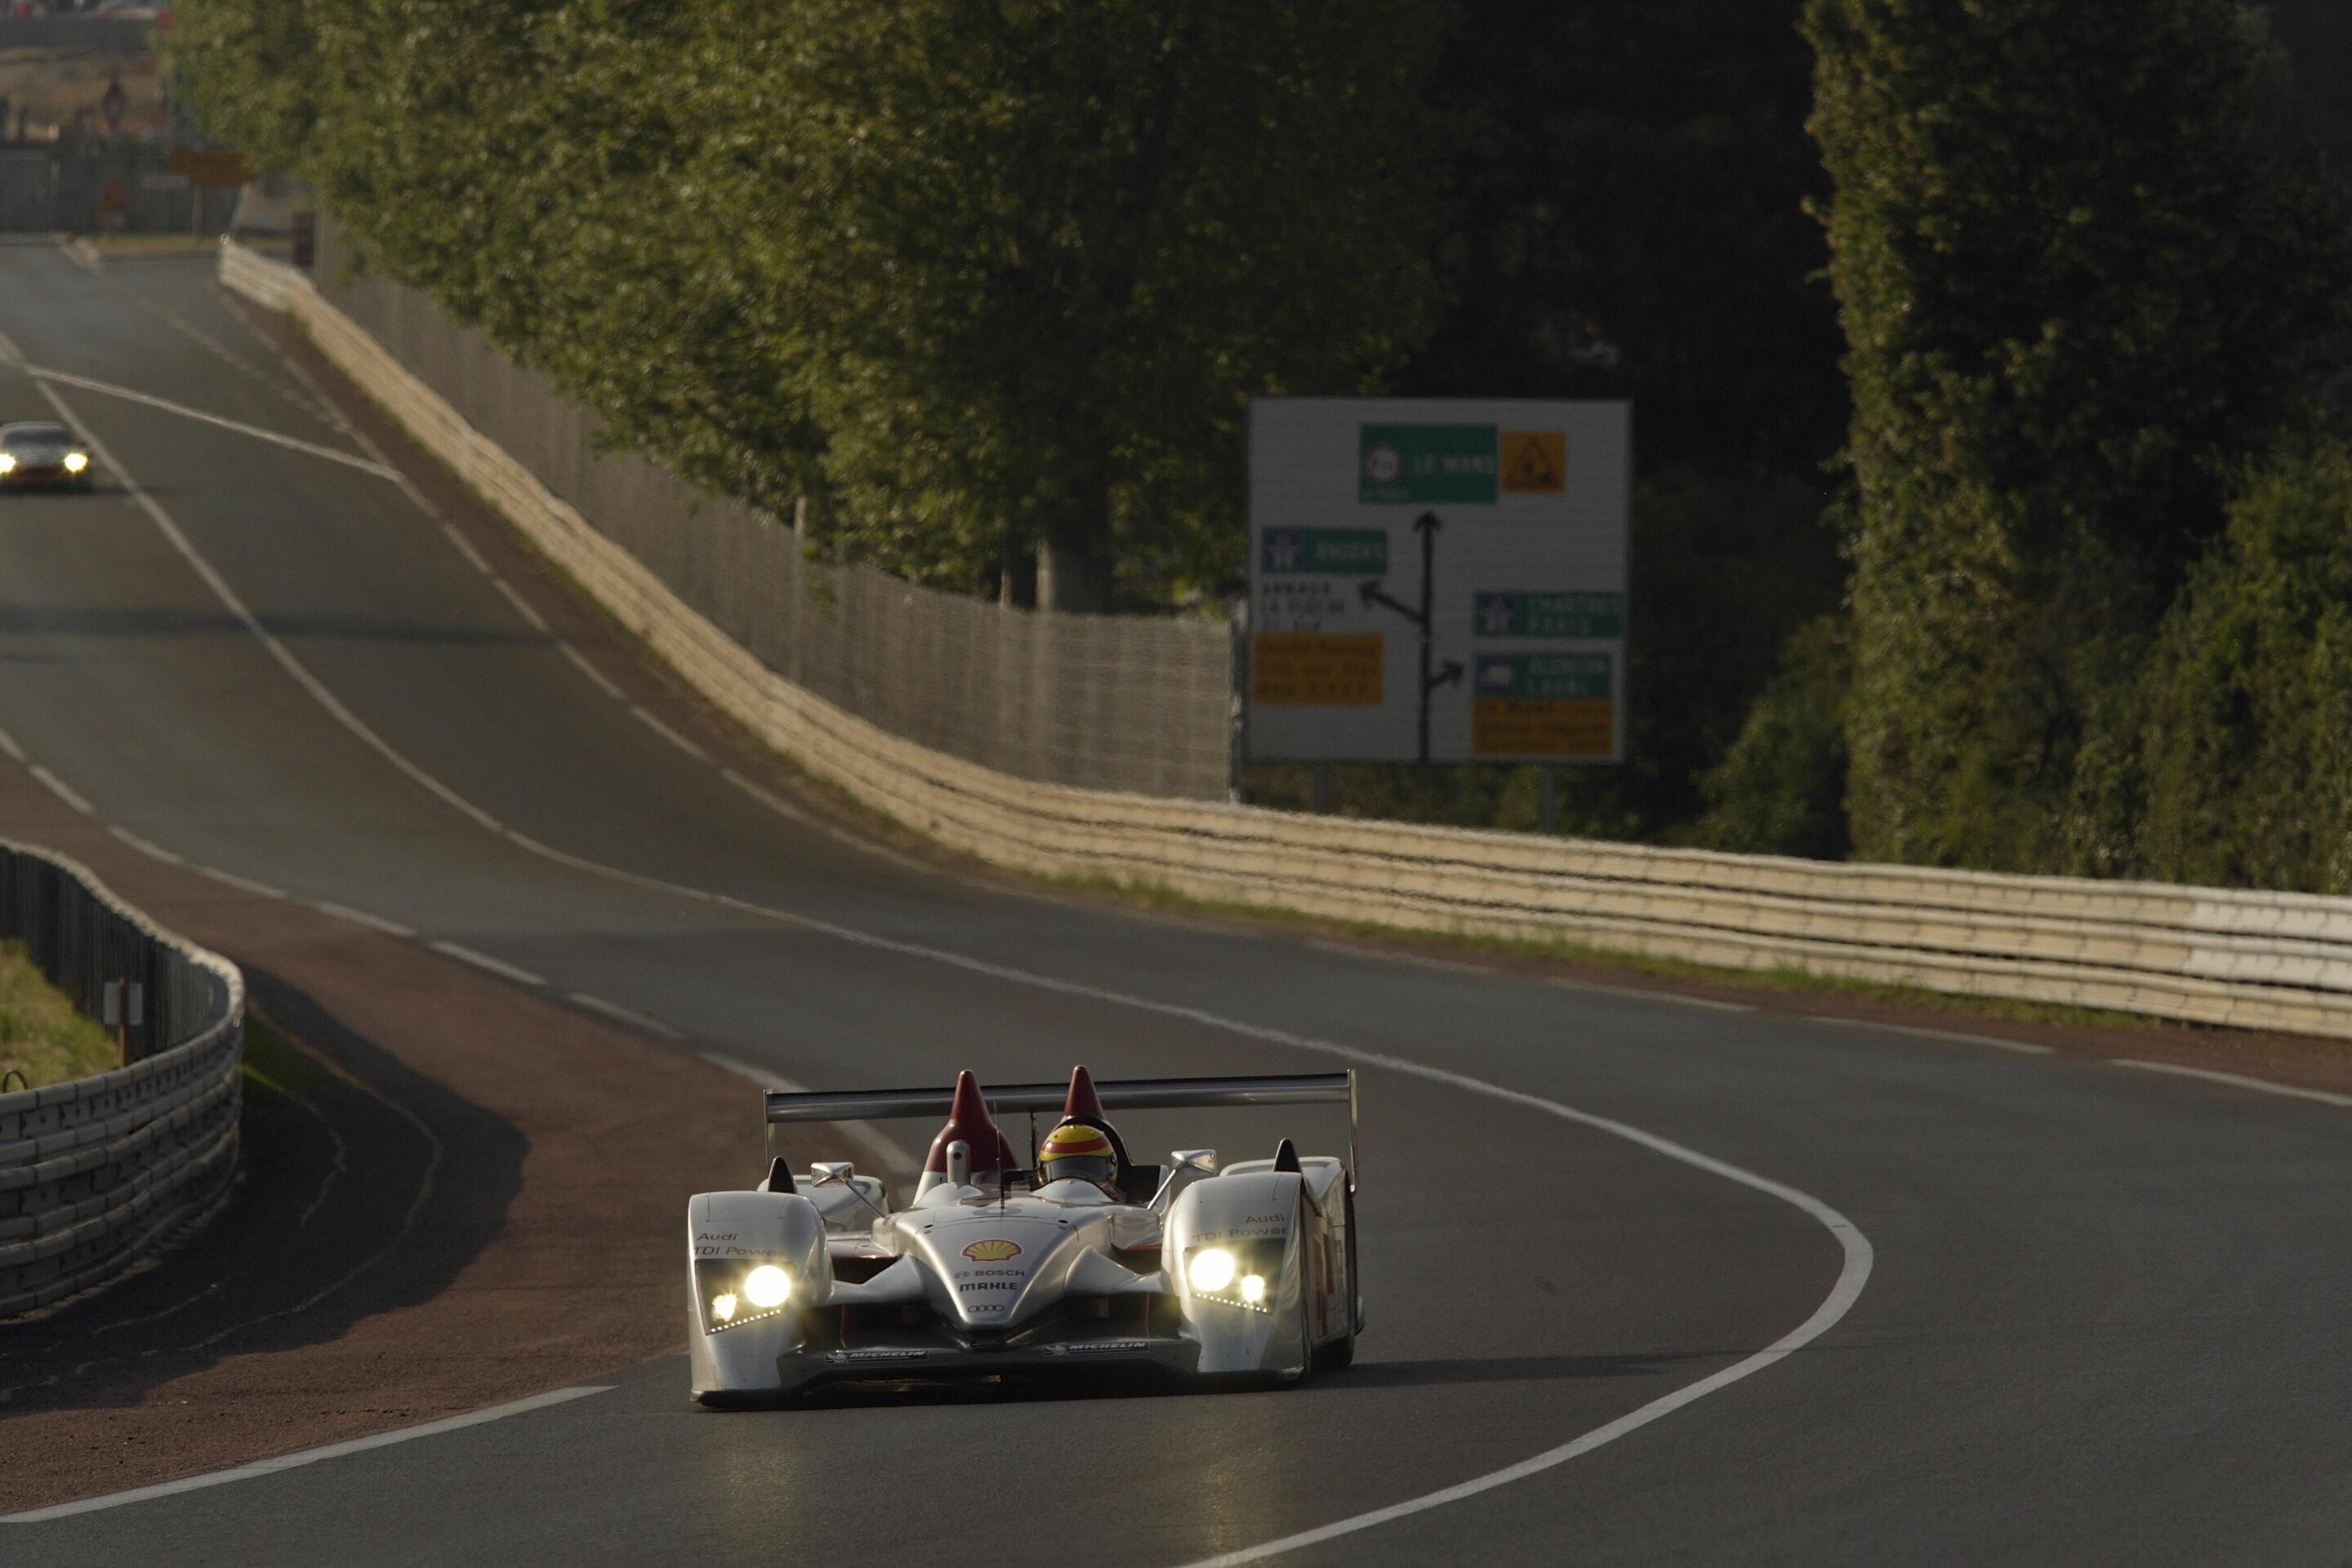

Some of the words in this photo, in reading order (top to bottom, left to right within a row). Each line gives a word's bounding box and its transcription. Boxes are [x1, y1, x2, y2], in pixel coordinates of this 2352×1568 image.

[1245, 1214, 1285, 1224] Audi
[697, 1232, 738, 1241] Audi
[1192, 1231, 1222, 1242] TDI
[1229, 1227, 1288, 1238] Power
[695, 1246, 720, 1256] TDI
[726, 1246, 789, 1259] Power
[960, 1282, 1018, 1292] MAHLE
[1069, 1342, 1147, 1352] MICHELIN
[849, 1351, 925, 1359] MICHELIN
